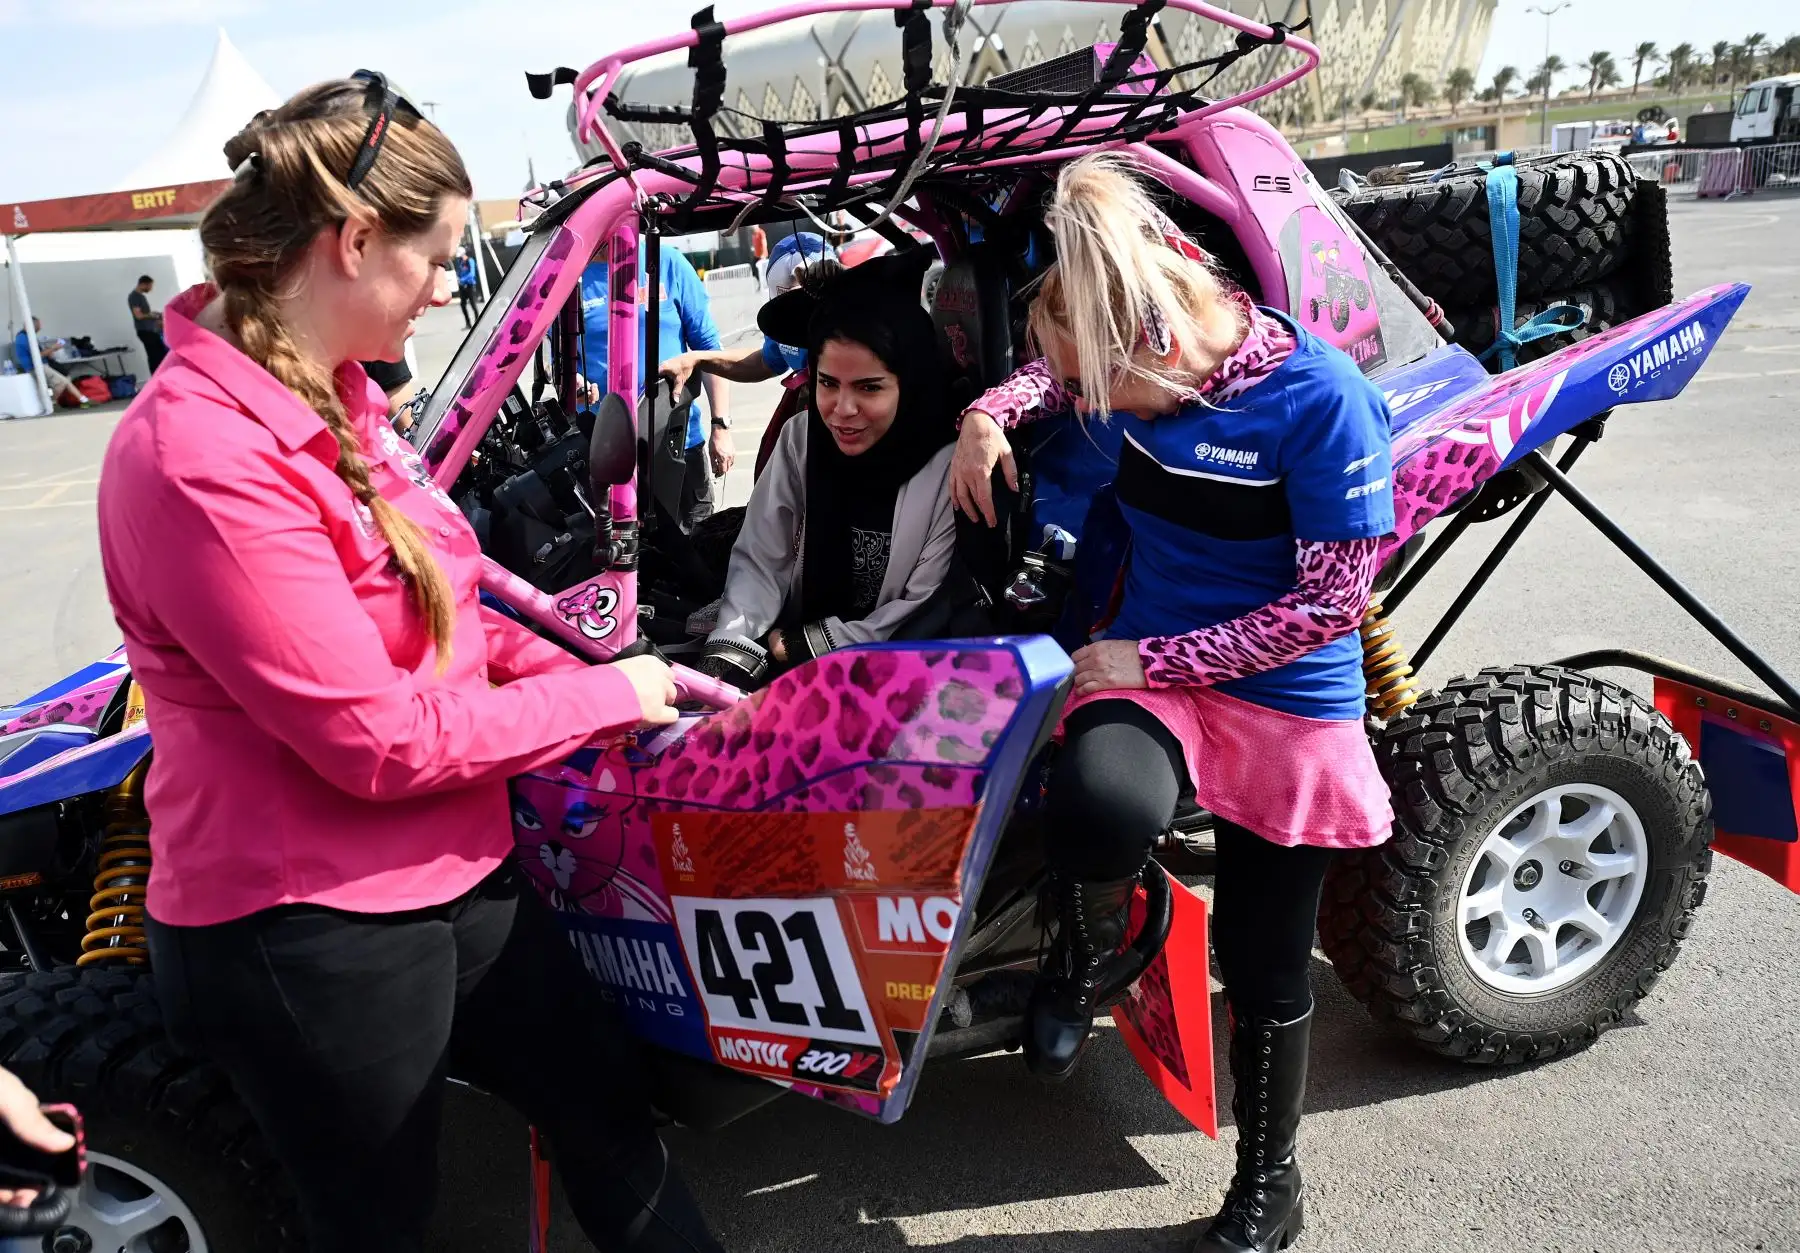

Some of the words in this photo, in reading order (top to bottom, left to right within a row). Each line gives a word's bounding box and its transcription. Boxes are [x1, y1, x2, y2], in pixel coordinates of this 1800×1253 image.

[131, 189, 176, 210] ERTF
[1618, 347, 1703, 397] RACING
[1629, 320, 1705, 379] YAMAHA
[1196, 455, 1253, 470] RACING
[1210, 445, 1259, 465] YAMAHA
[876, 896, 961, 944] MO
[569, 930, 687, 998] AMAHA
[695, 908, 866, 1033] 421
[718, 1036, 789, 1069] MOTUL
[797, 1050, 880, 1078] 300V
